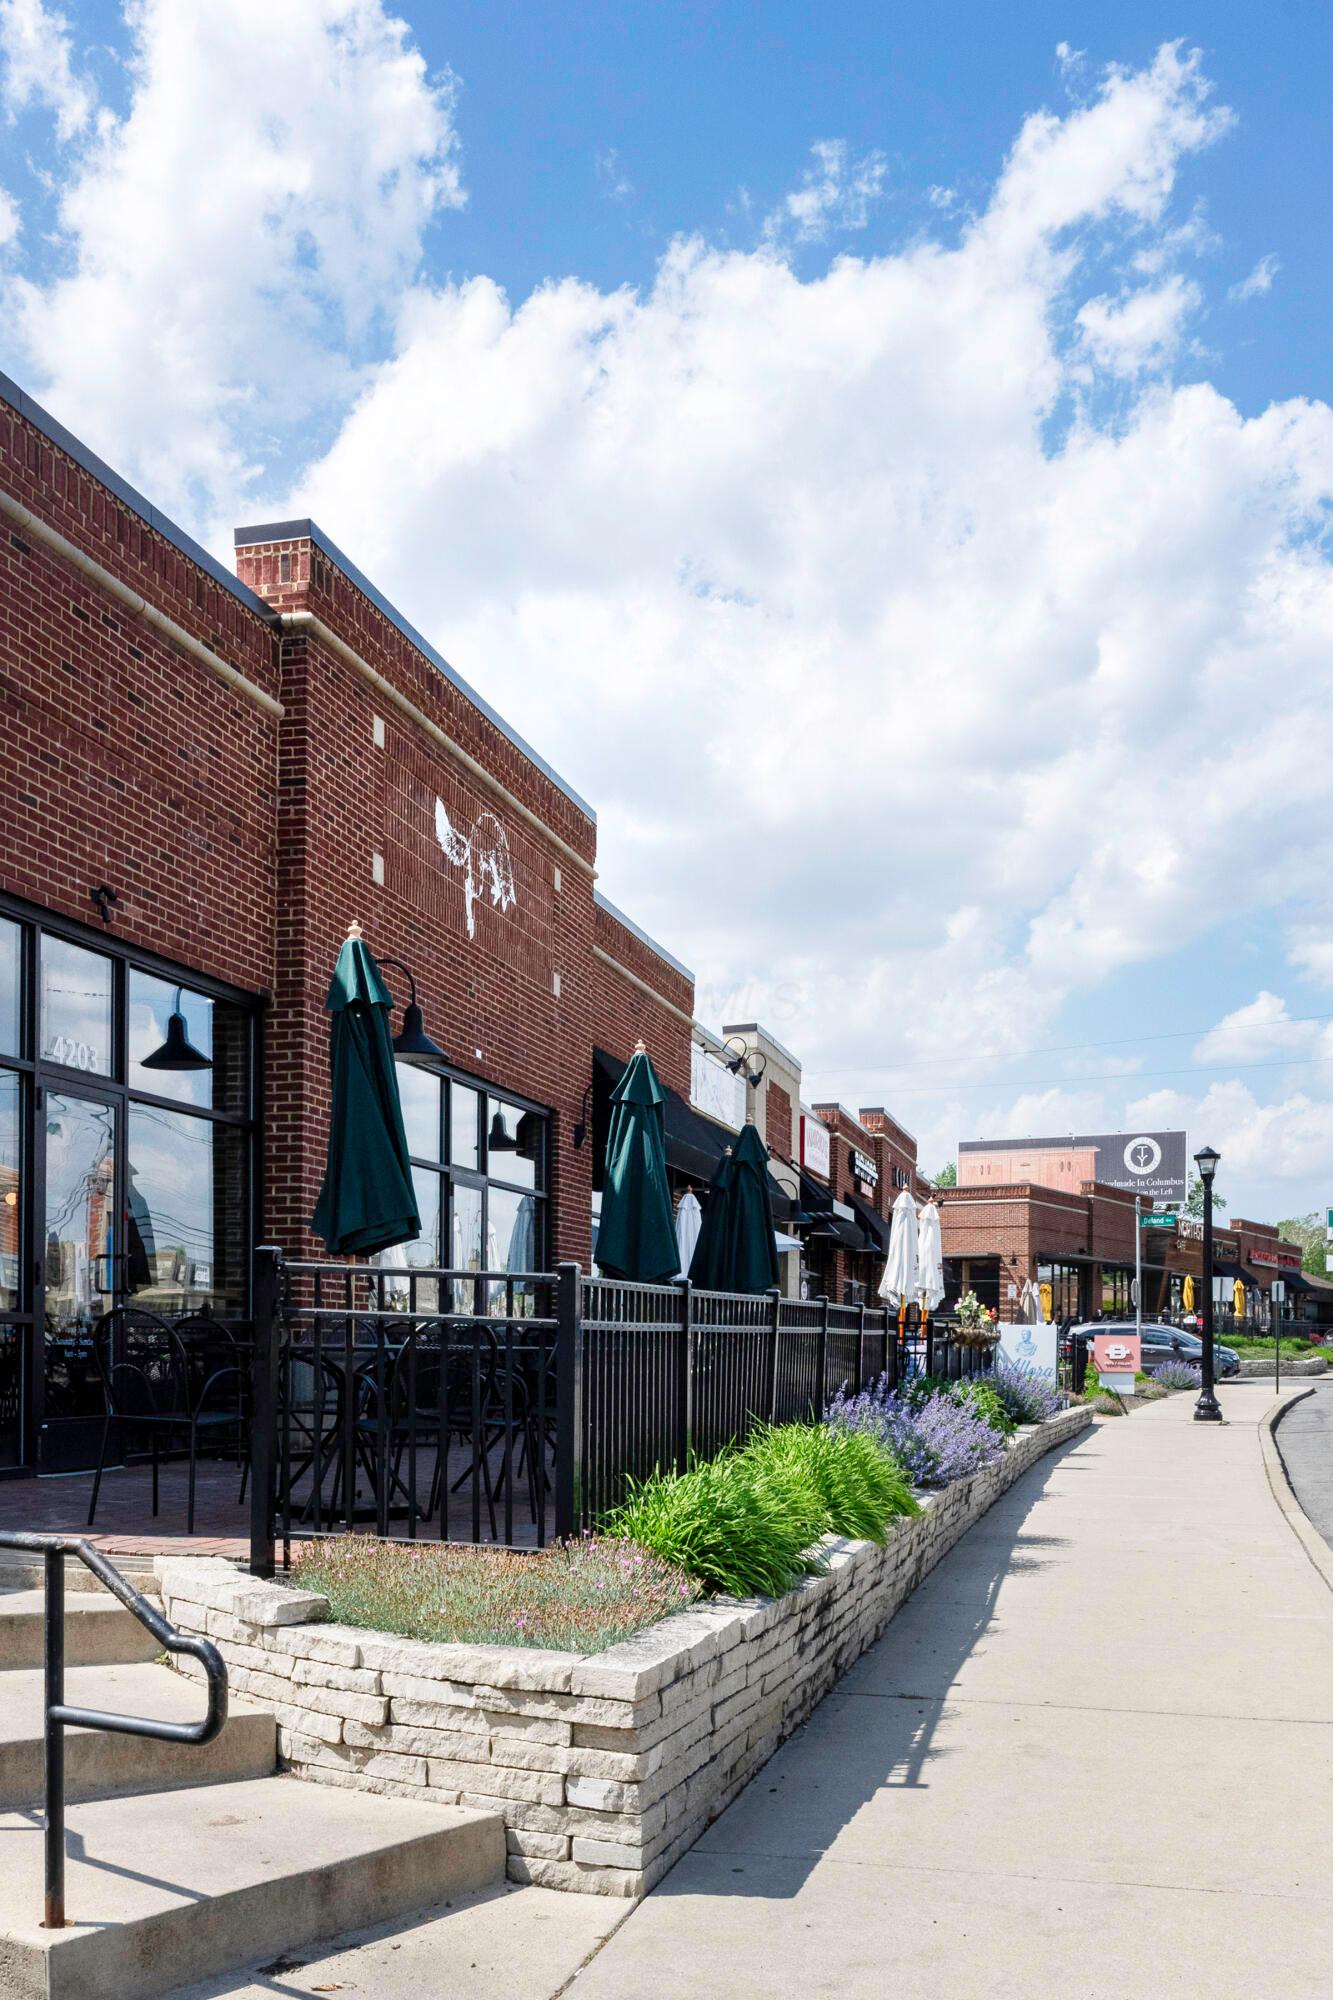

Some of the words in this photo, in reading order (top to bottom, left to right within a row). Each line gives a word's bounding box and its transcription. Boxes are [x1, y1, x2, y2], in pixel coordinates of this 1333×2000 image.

[53, 1036, 98, 1073] 4203
[1137, 1178, 1145, 1187] In
[1146, 1177, 1184, 1187] Columbus
[1143, 1216, 1165, 1225] Deland
[1008, 1358, 1055, 1377] Allora
